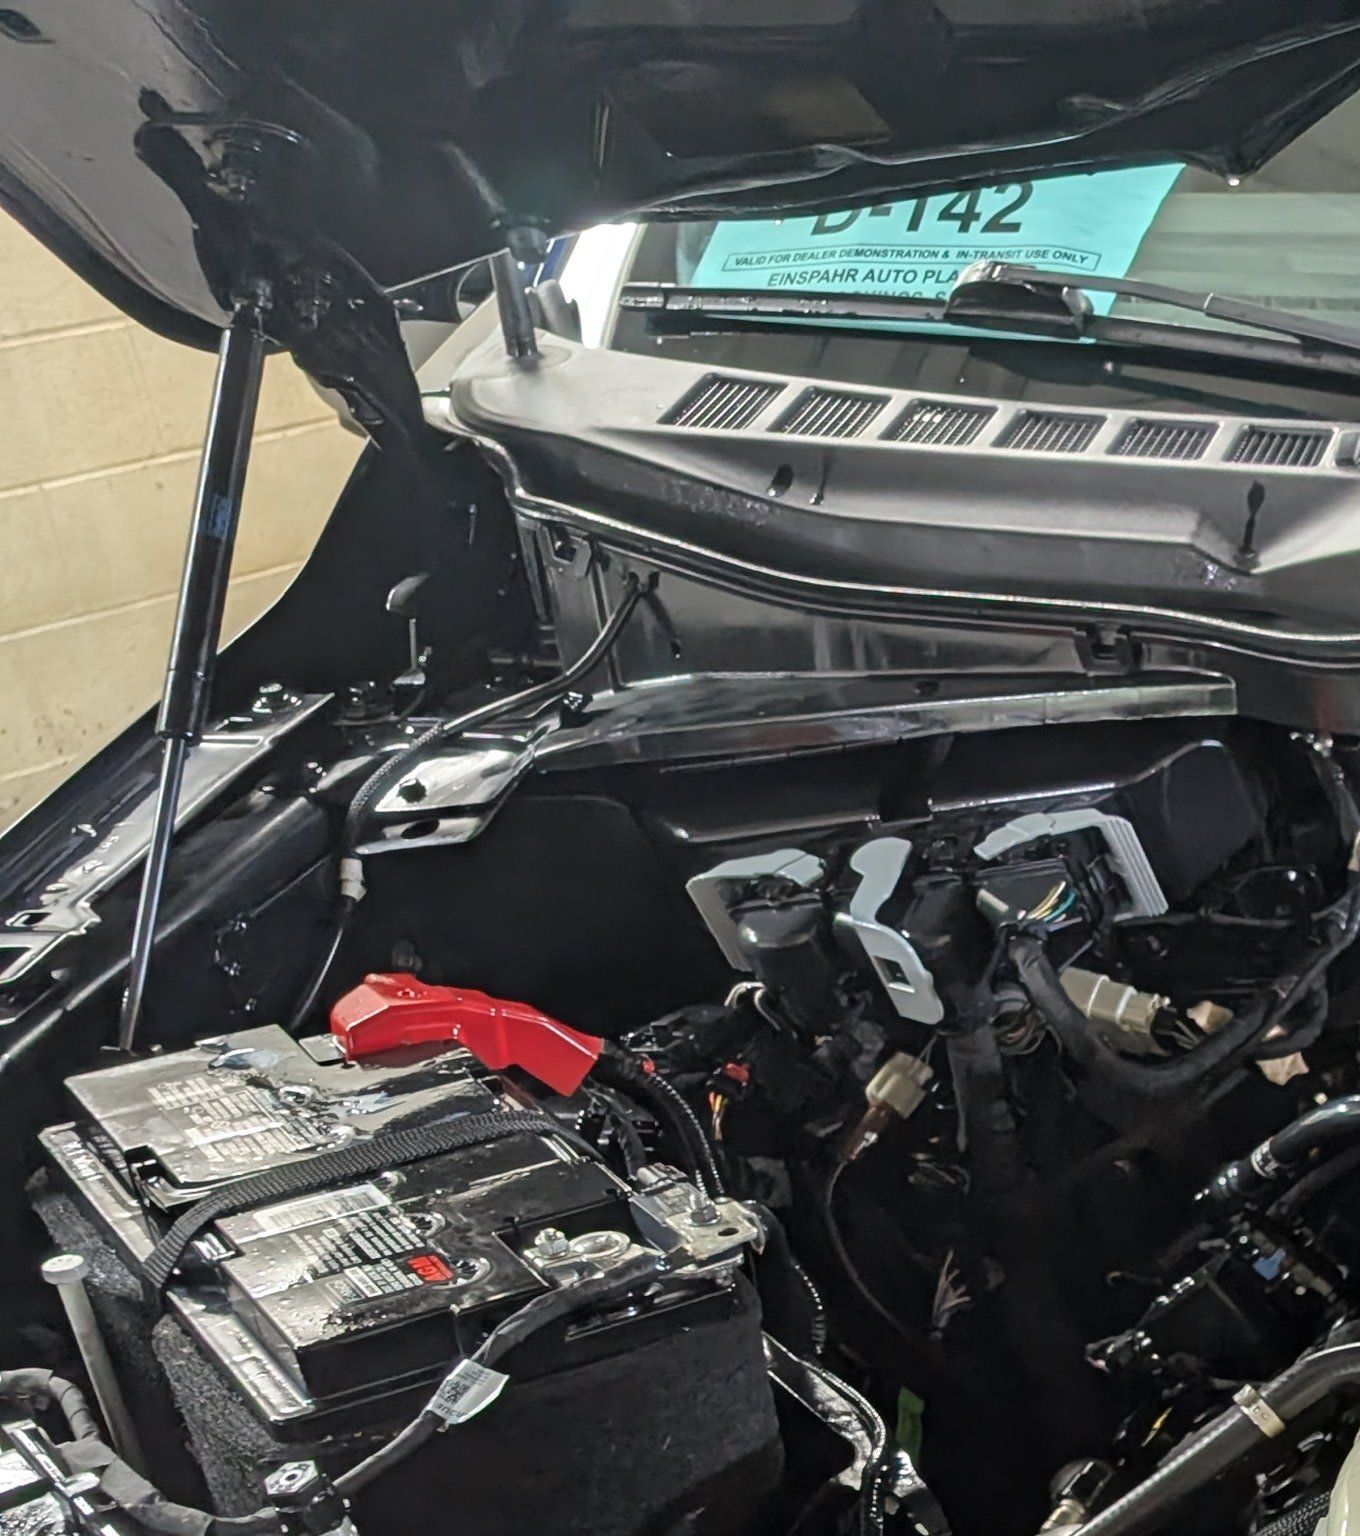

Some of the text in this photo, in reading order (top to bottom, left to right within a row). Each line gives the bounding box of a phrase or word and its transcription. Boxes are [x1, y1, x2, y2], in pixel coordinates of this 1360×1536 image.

[735, 248, 1089, 266] VALID FOR DEALER DEMONSTRATION & IN-TRANSIT USE ONLY
[767, 268, 860, 287] EINSPAHR
[862, 268, 918, 284] AUTO
